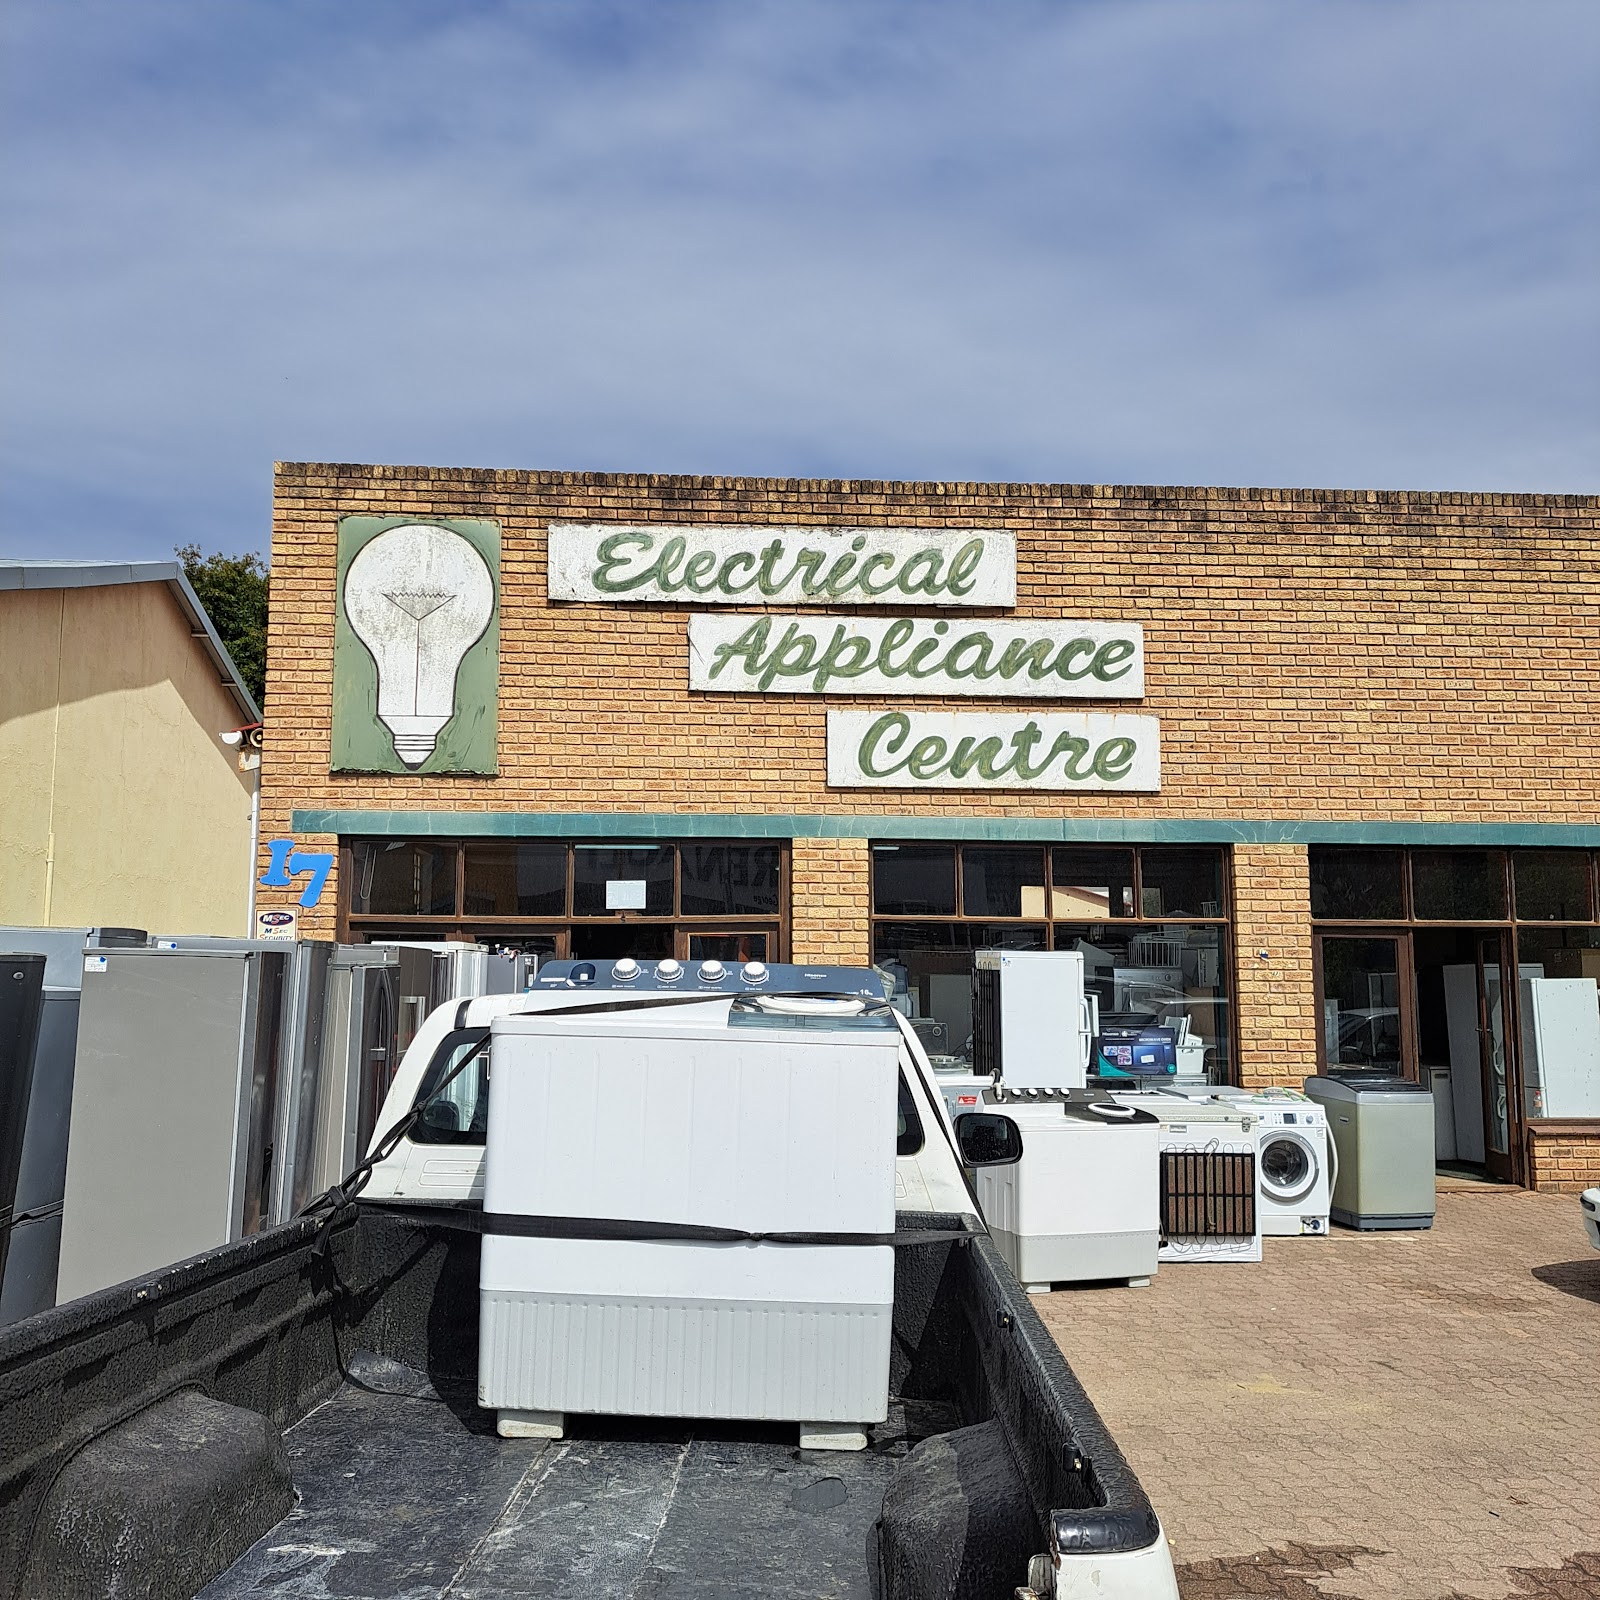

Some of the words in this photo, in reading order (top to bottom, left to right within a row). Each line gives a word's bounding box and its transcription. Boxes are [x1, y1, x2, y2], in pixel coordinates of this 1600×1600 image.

[591, 531, 984, 596] Electrical
[708, 615, 1135, 691] Appliance
[858, 712, 1136, 780] Centre
[260, 839, 334, 908] 17
